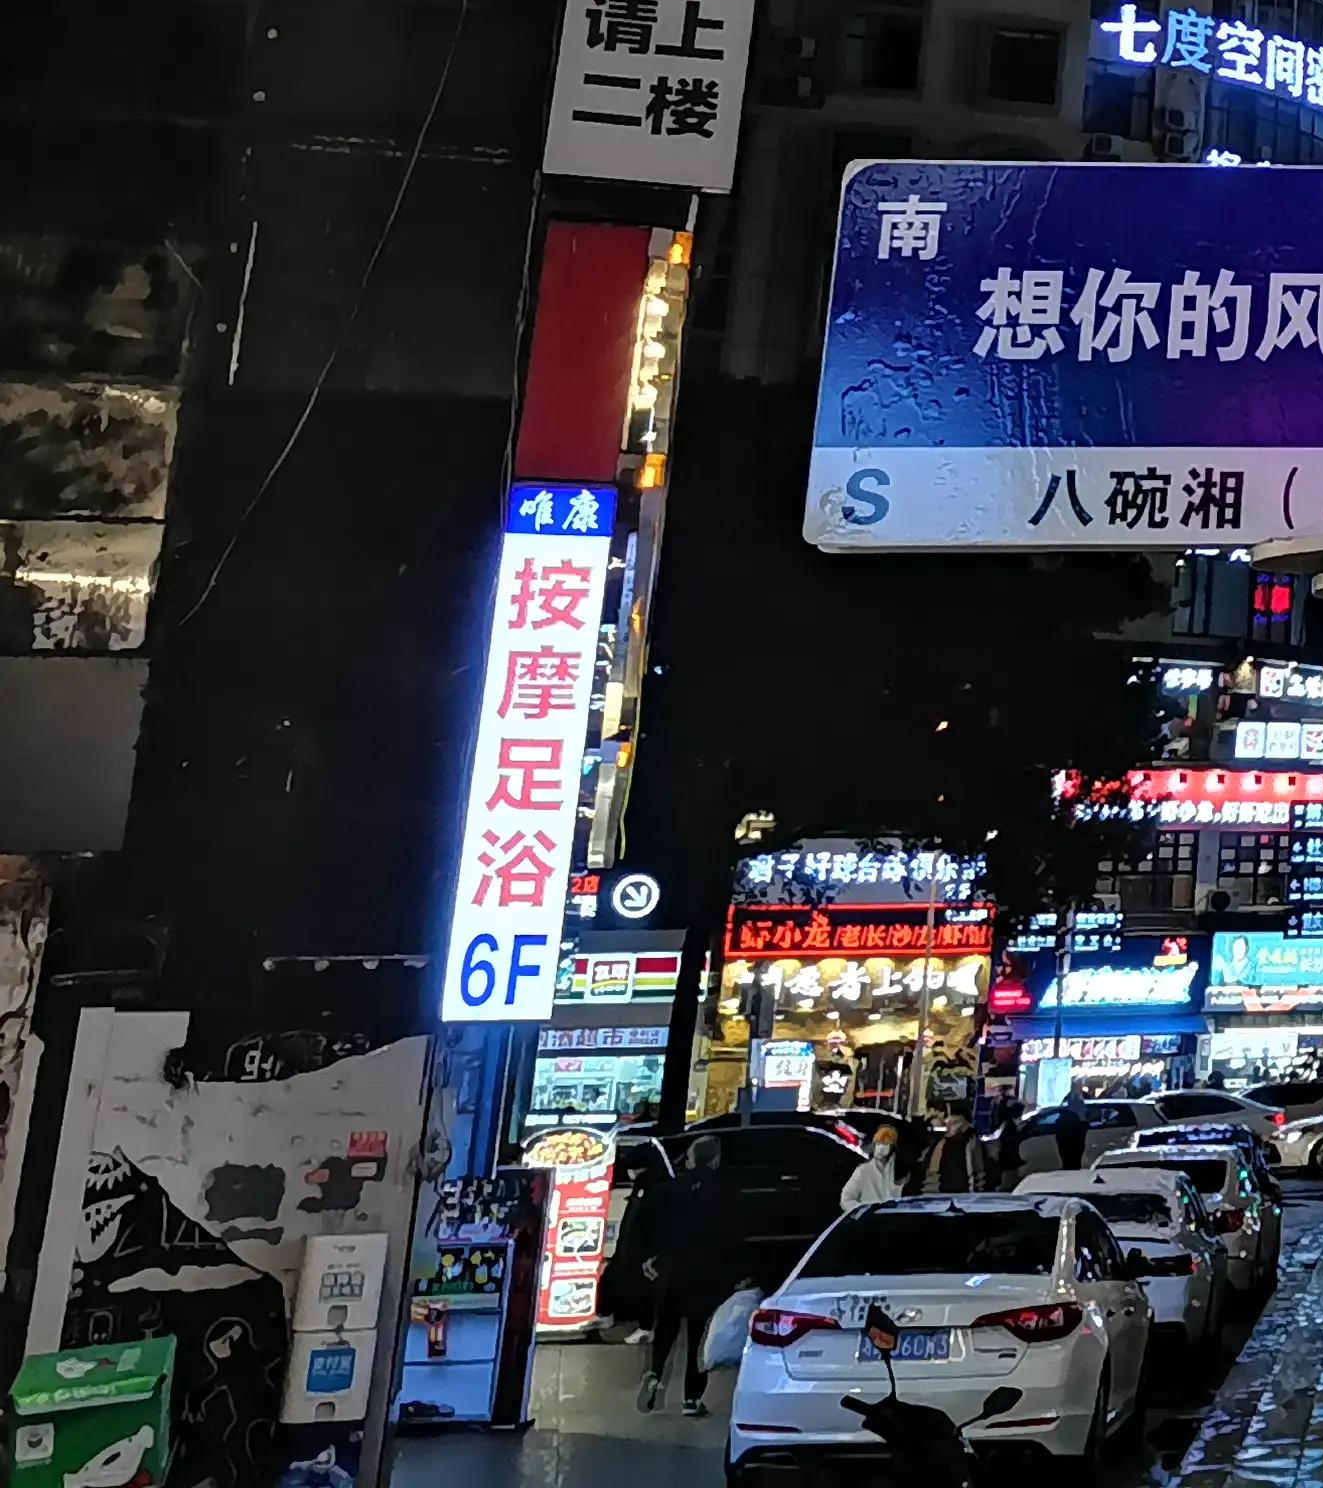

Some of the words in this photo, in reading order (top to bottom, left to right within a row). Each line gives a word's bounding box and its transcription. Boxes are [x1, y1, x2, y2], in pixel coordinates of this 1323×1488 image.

[572, 72, 719, 138] 二楼
[878, 194, 947, 260] 南
[841, 468, 891, 525] S
[472, 558, 591, 908] 按摩足浴
[459, 933, 549, 1007] 6F
